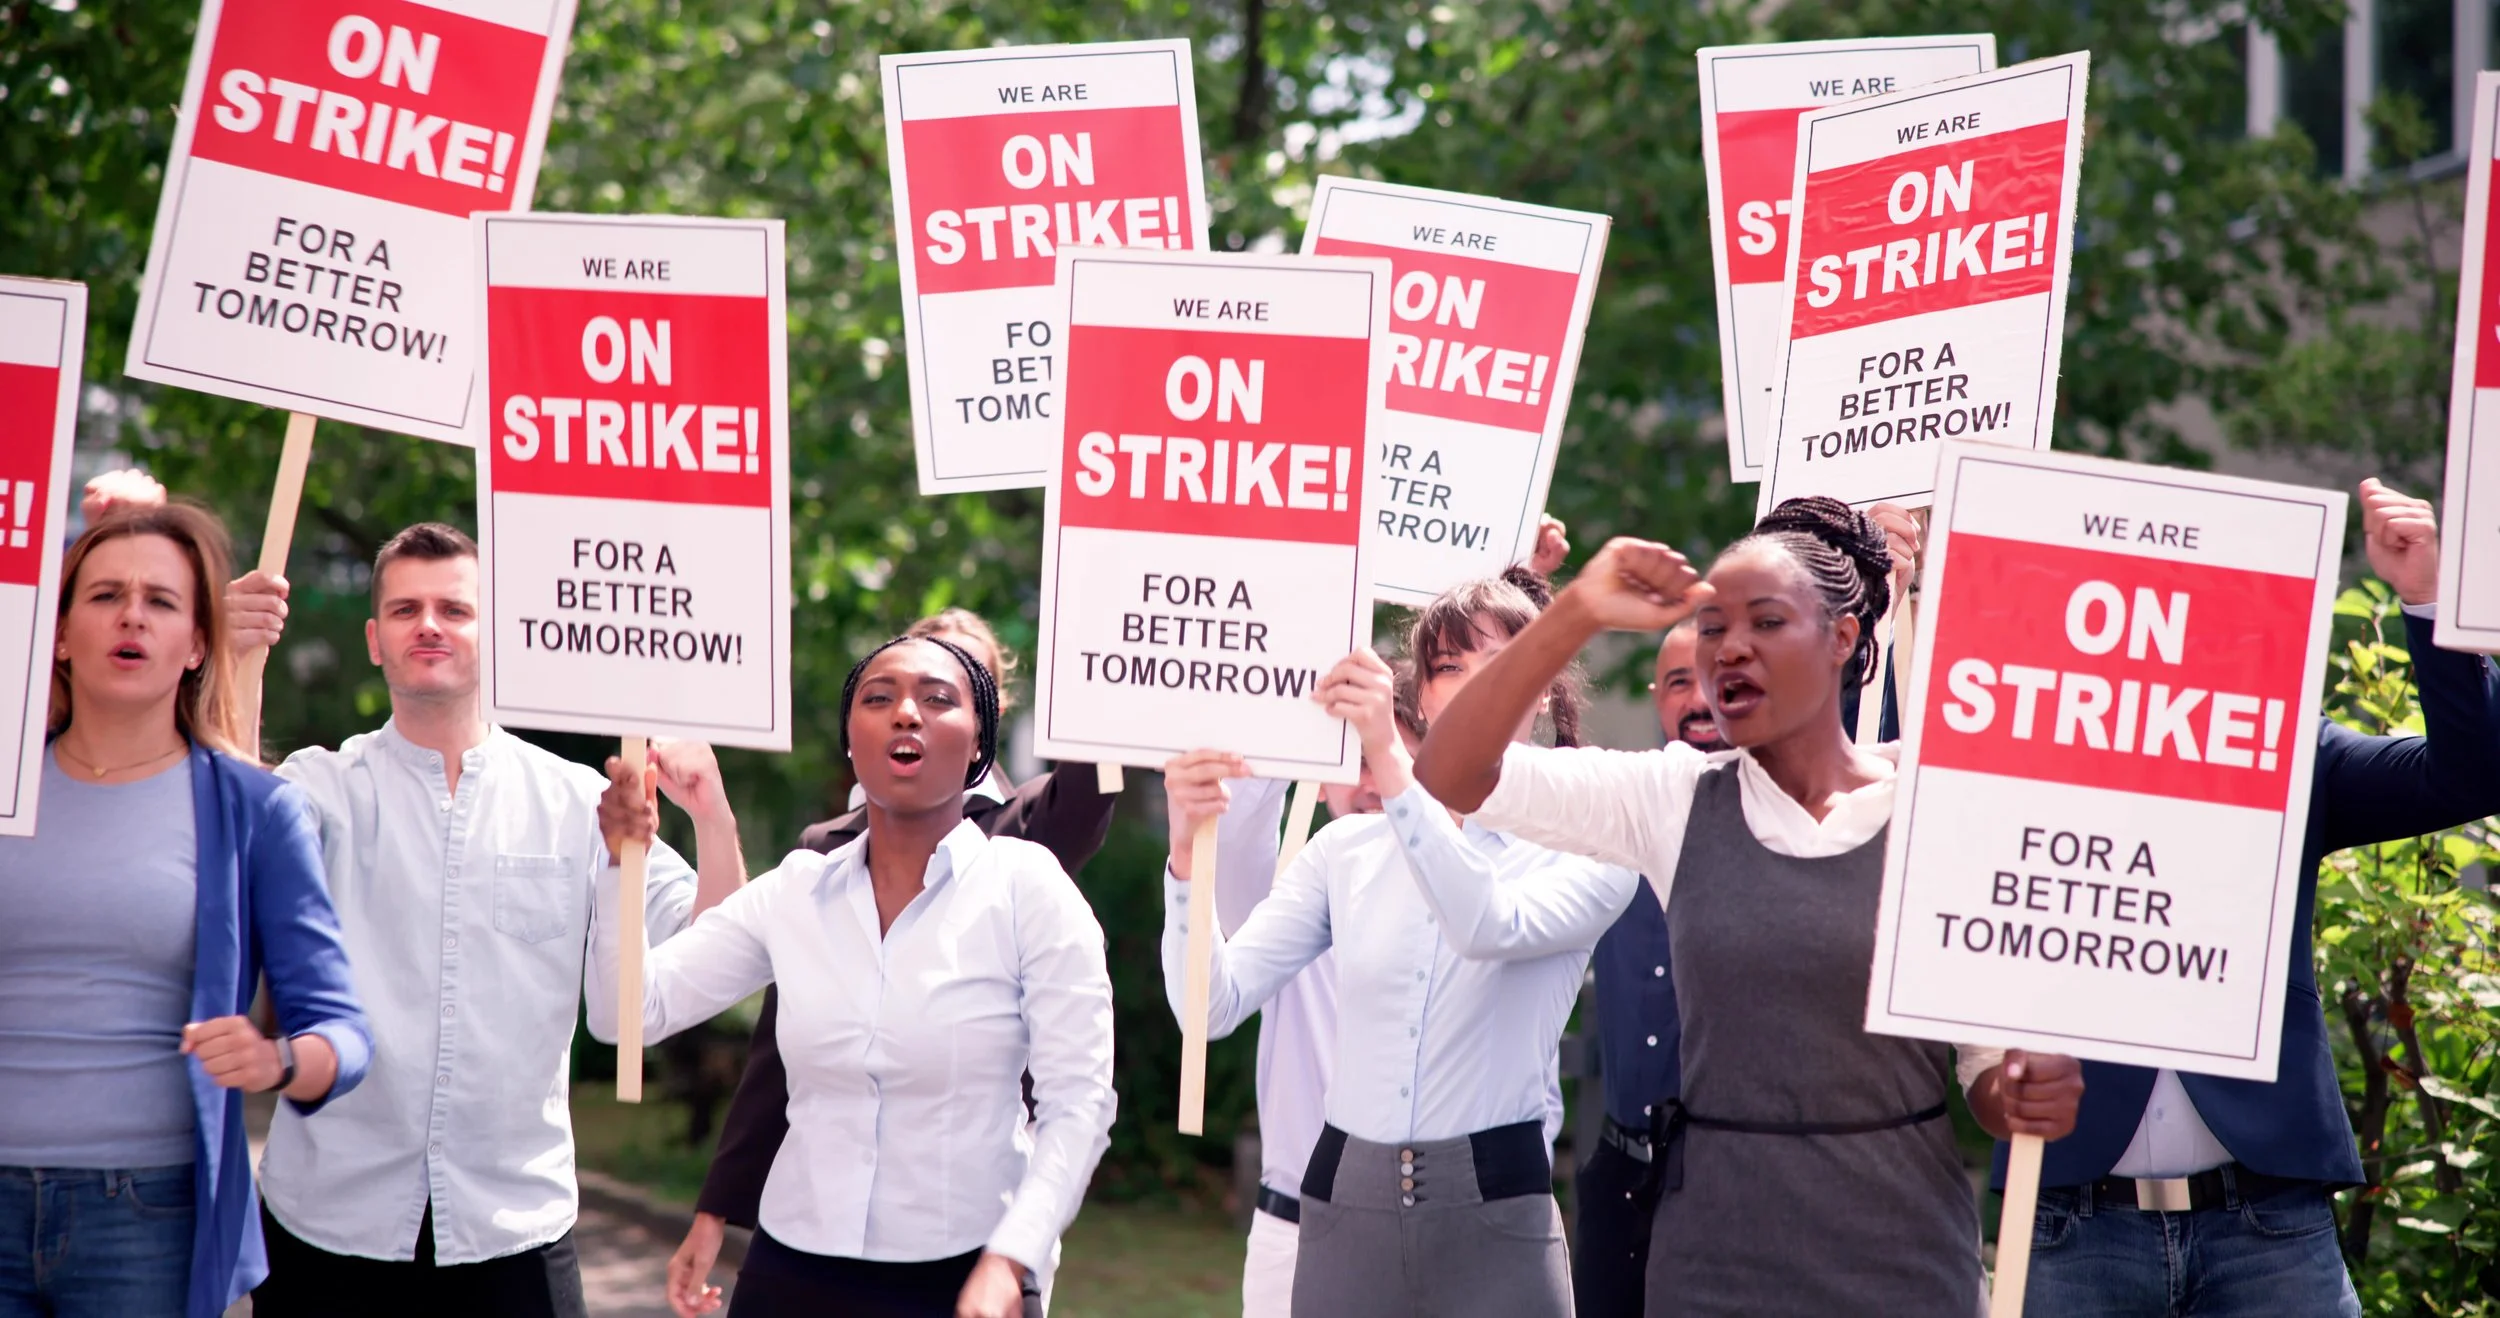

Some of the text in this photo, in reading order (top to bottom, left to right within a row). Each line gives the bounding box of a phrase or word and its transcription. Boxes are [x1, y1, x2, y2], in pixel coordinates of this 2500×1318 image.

[328, 15, 440, 94] ON
[998, 84, 1087, 103] WE ARE
[1810, 77, 1896, 97] WE ARE
[214, 70, 514, 192] STRIKE!
[1897, 112, 1980, 144] WE ARE
[1002, 133, 1094, 189] ON
[1888, 160, 1974, 224] ON
[274, 217, 390, 270] FOR A
[926, 197, 1182, 265] STRIKE!
[1414, 225, 1496, 251] WE ARE
[245, 251, 402, 312] BETTER
[583, 258, 669, 280] WE ARE
[1807, 212, 2048, 307] STRIKE!
[194, 280, 446, 363] TOMORROW!
[1174, 299, 1268, 321] WE ARE
[1392, 271, 1485, 329] ON
[582, 316, 671, 385] ON
[1007, 321, 1051, 348] FO
[1166, 356, 1264, 423] ON
[1386, 331, 1550, 406] RIKE!
[1859, 343, 1955, 383] FOR A
[1840, 374, 1968, 420] BETTER
[503, 395, 759, 473] STRIKE!
[1802, 402, 2010, 461] TOMORROW!
[1076, 432, 1351, 511] STRIKE!
[1420, 448, 1445, 477] A
[574, 539, 676, 575] FOR A
[1378, 510, 1489, 551] RROW!
[2084, 513, 2200, 549] WE ARE
[557, 579, 692, 618] BETTER
[1143, 574, 1252, 610] FOR A
[520, 619, 741, 664] TOMORROW!
[1123, 613, 1267, 652] BETTER
[2066, 581, 2189, 664] ON
[1081, 652, 1316, 698] TOMORROW!
[1943, 659, 2284, 771] STRIKE!
[2021, 827, 2155, 877] FOR A
[1992, 871, 2172, 927] BETTER
[1936, 913, 2227, 983] TOMORROW!
